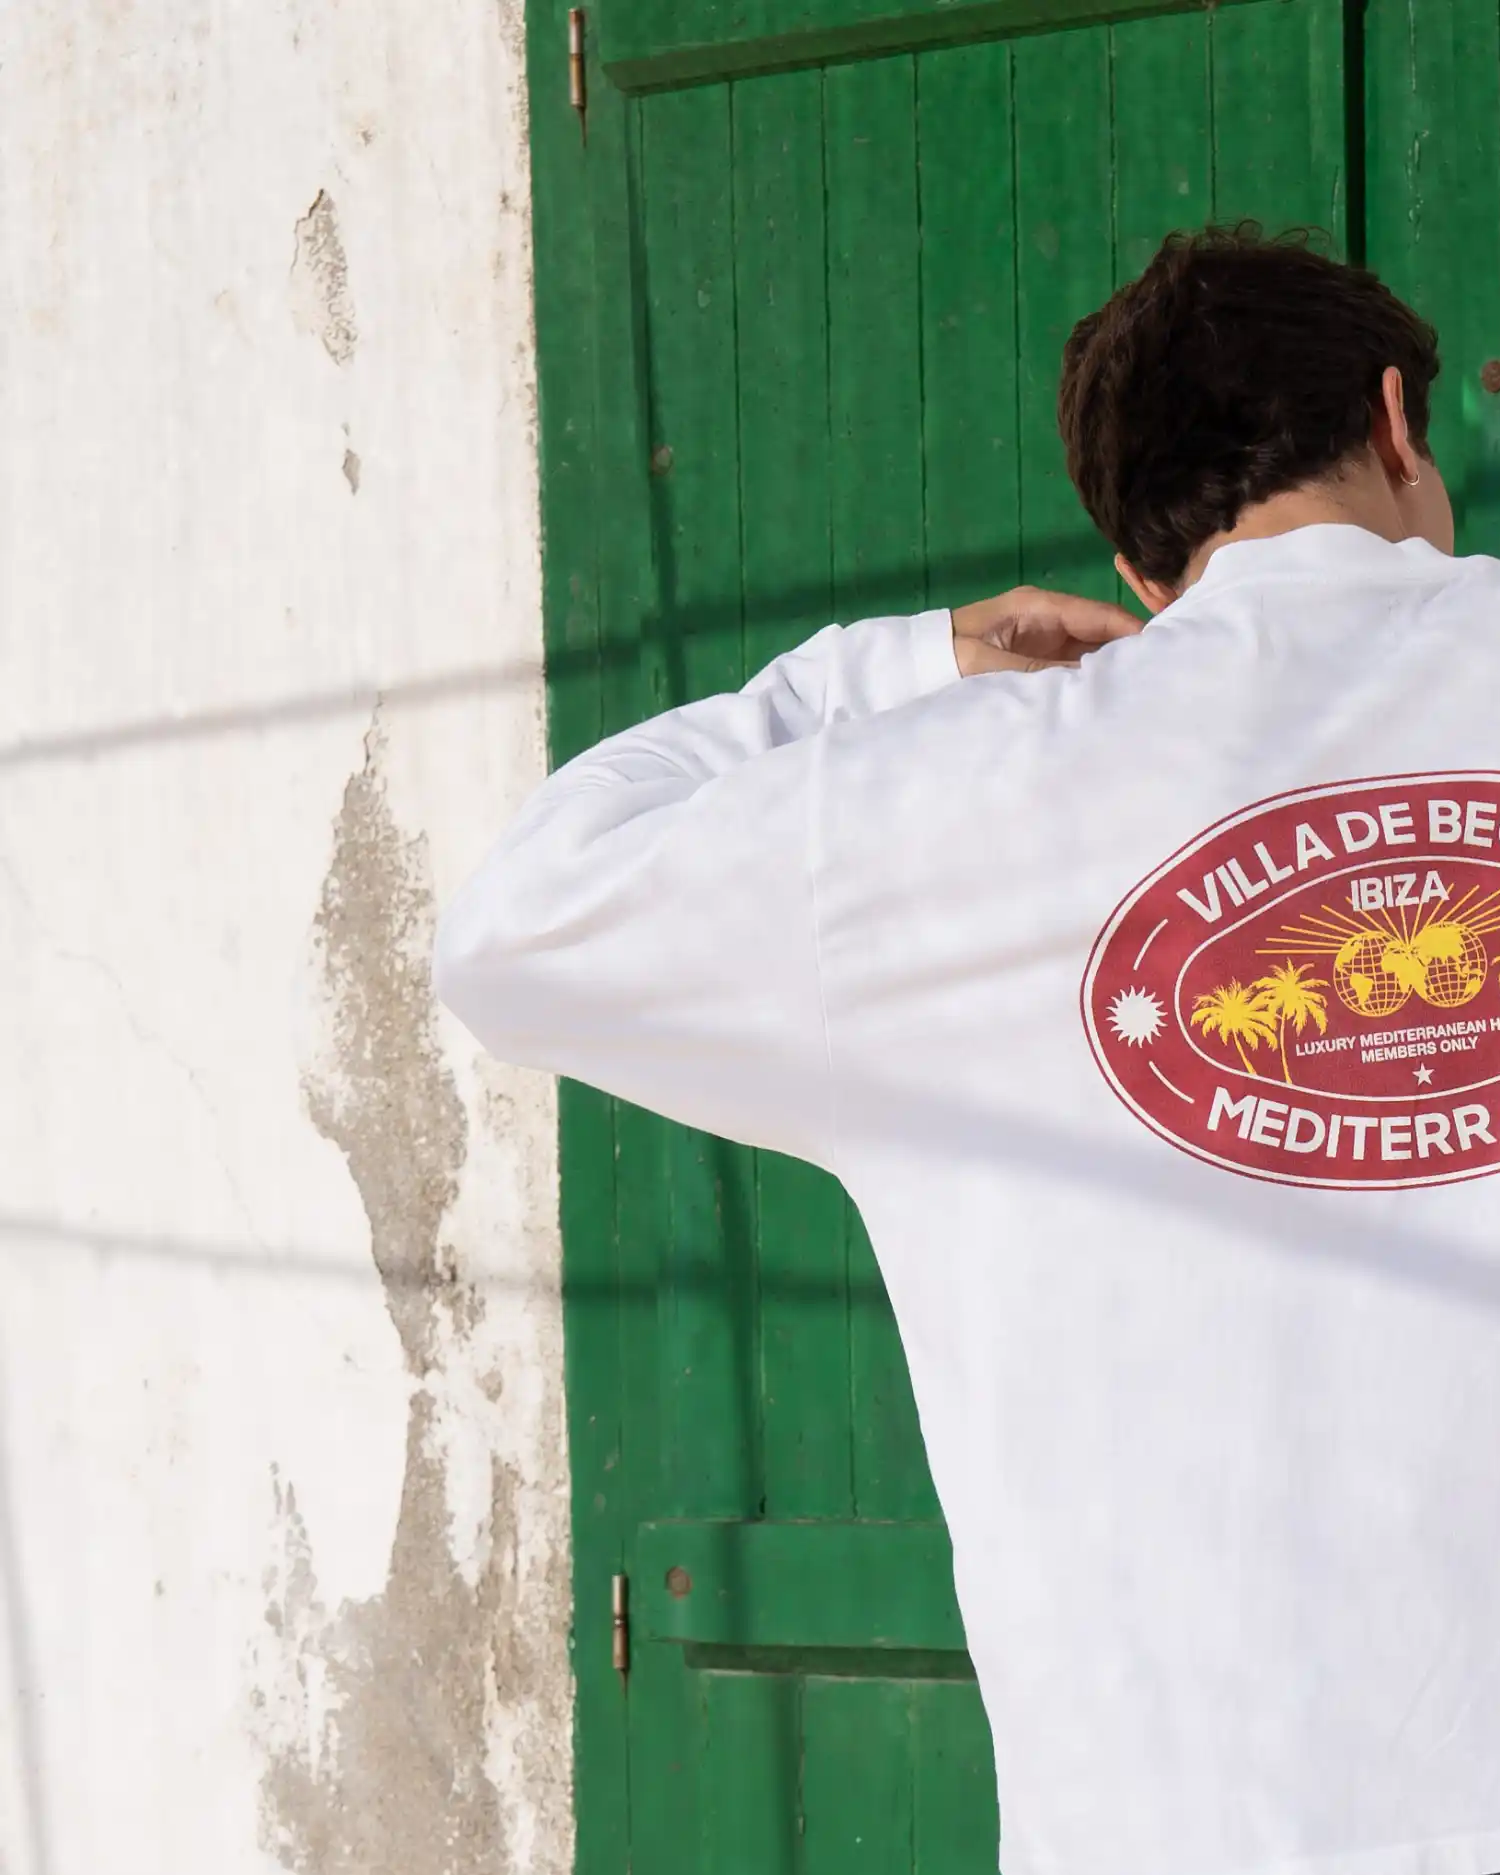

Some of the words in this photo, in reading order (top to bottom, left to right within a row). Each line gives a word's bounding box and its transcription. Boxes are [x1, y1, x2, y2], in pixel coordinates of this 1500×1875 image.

[1176, 822, 1336, 923] VILLA
[1335, 802, 1417, 854] DE
[1350, 871, 1450, 913] IBIZA
[1295, 1035, 1357, 1057] LUXURY
[1359, 1019, 1487, 1047] MEDITERRANEAN
[1361, 1040, 1437, 1064] MEMBERS
[1439, 1035, 1479, 1054] ONLY
